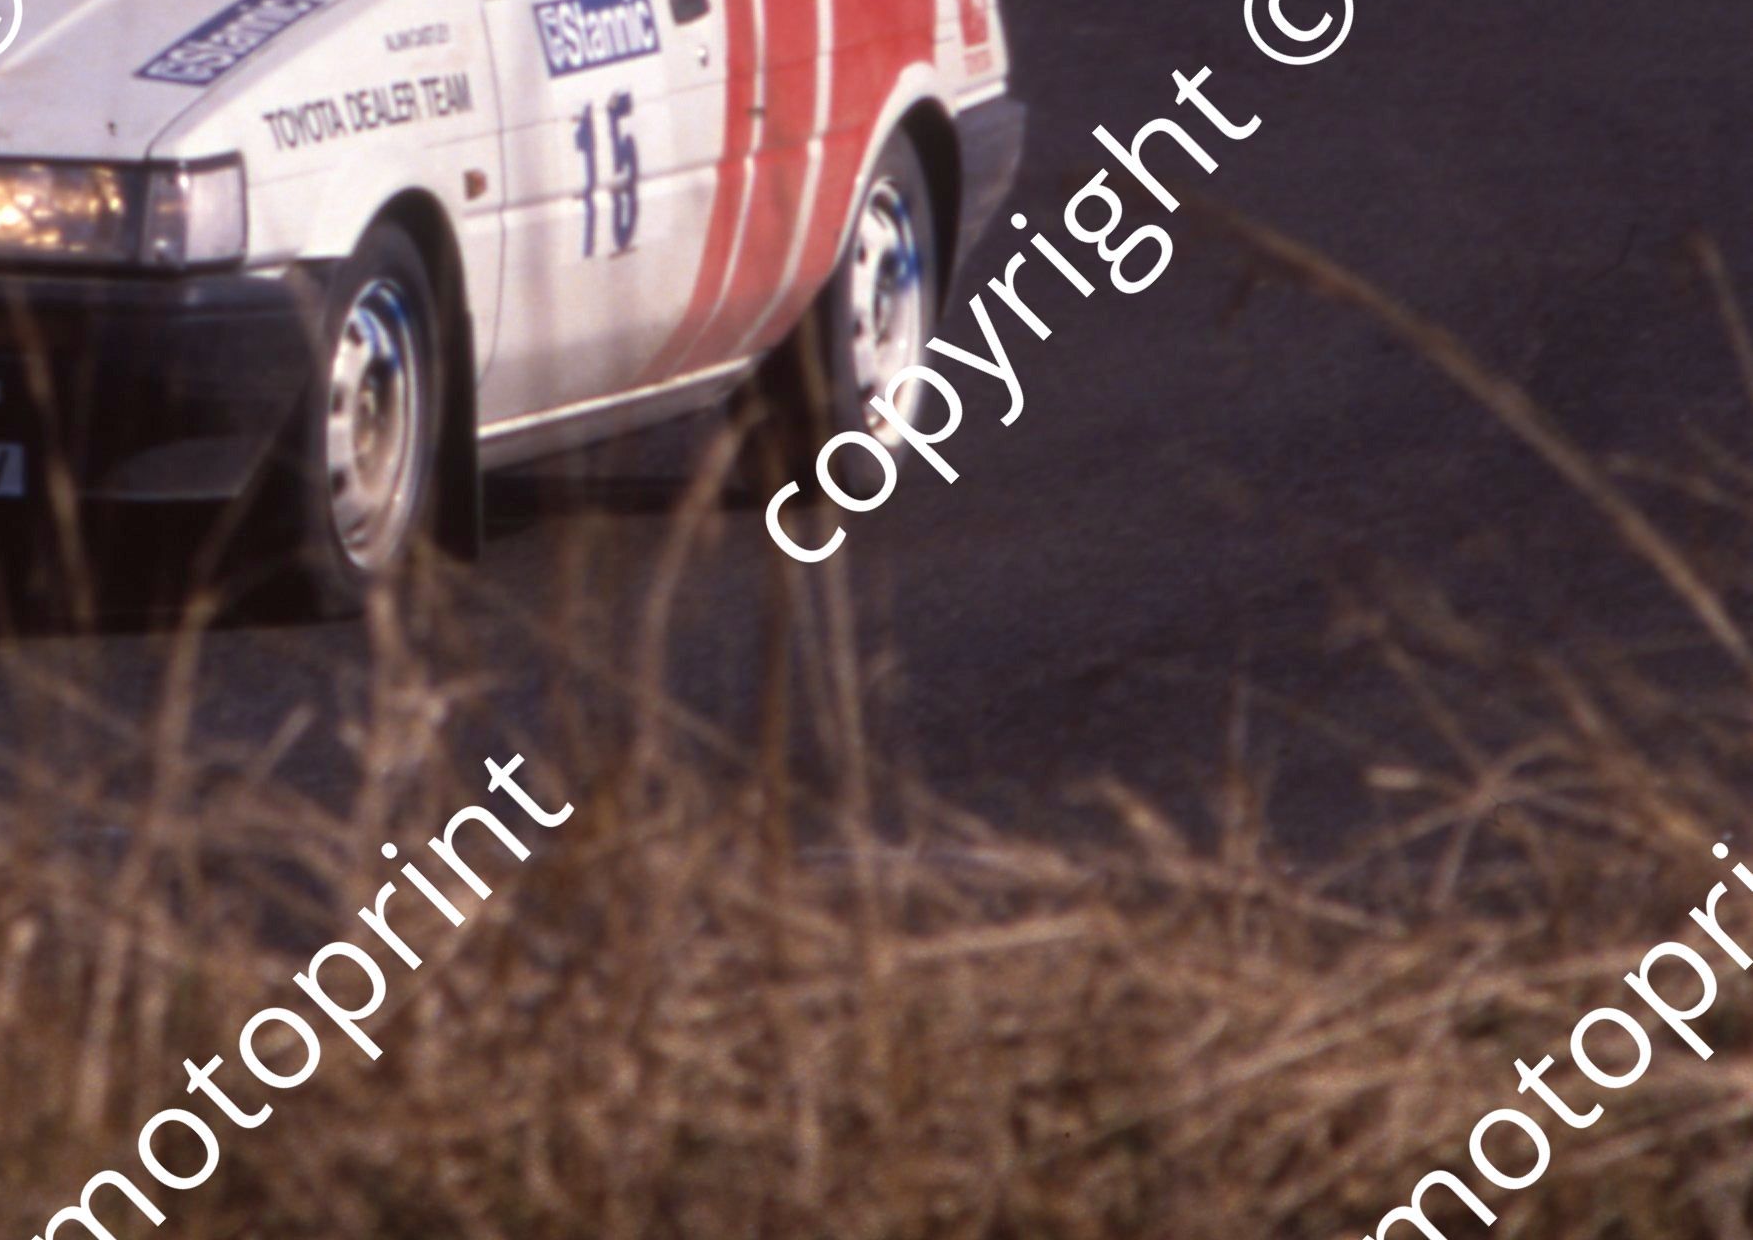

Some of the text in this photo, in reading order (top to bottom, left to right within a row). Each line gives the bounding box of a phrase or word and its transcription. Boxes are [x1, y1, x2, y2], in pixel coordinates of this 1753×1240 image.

[262, 72, 473, 151] TOYOTA DEALER TEAM
[574, 90, 640, 259] 15
